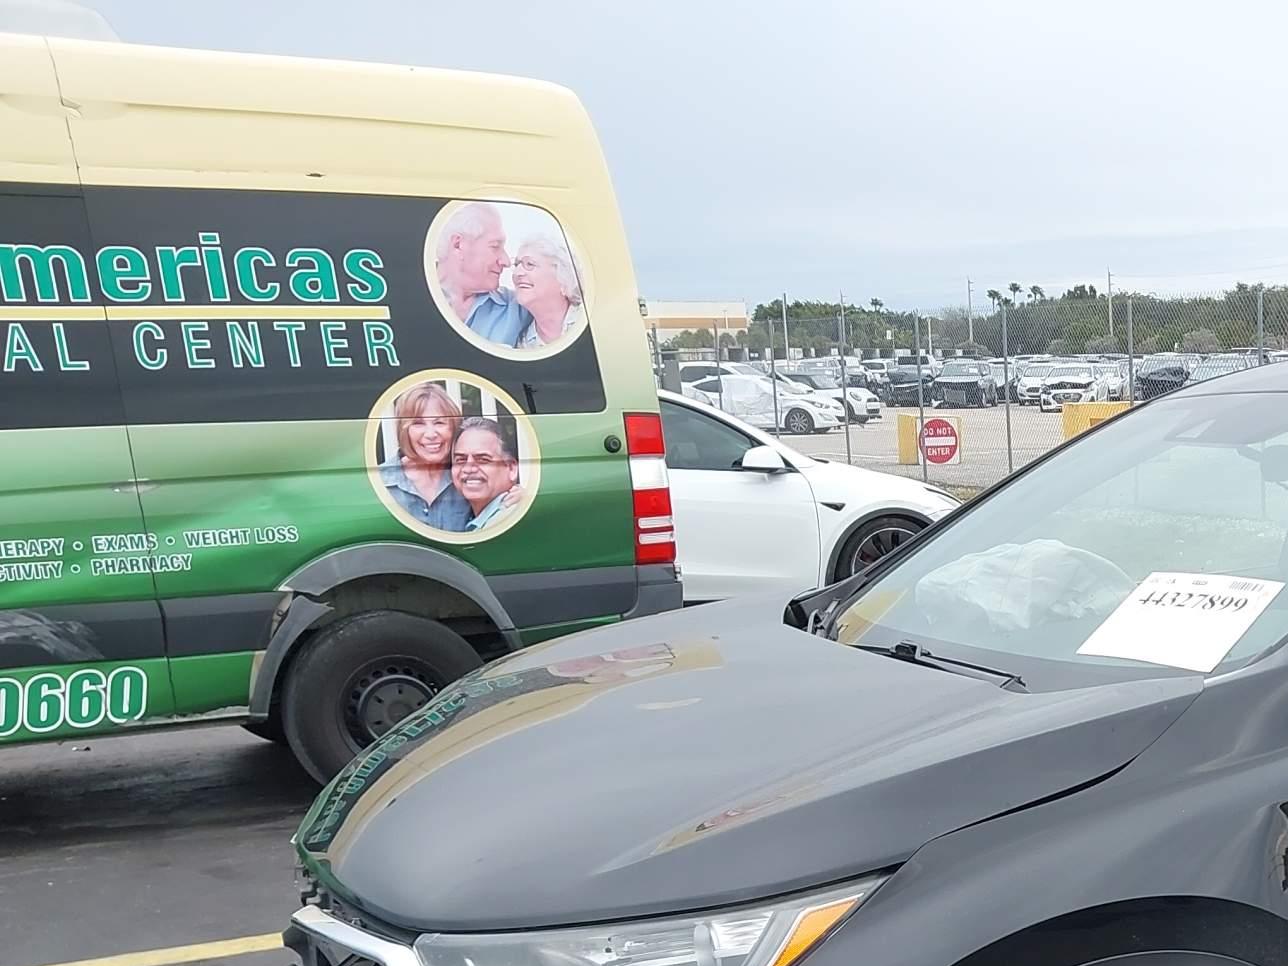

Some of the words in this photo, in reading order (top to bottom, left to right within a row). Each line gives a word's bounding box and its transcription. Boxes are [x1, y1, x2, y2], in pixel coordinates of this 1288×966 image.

[3, 323, 90, 372] AL
[132, 321, 400, 370] CENTER
[923, 427, 934, 436] DO
[936, 426, 952, 436] NOT
[927, 447, 951, 456] ENTER
[0, 538, 64, 559] ERAPY
[92, 533, 158, 553] EXAMS
[183, 528, 250, 548] WEIGHT
[255, 526, 298, 544] LOSS
[91, 554, 192, 576] PHARMACY
[1138, 591, 1249, 612] 44327899
